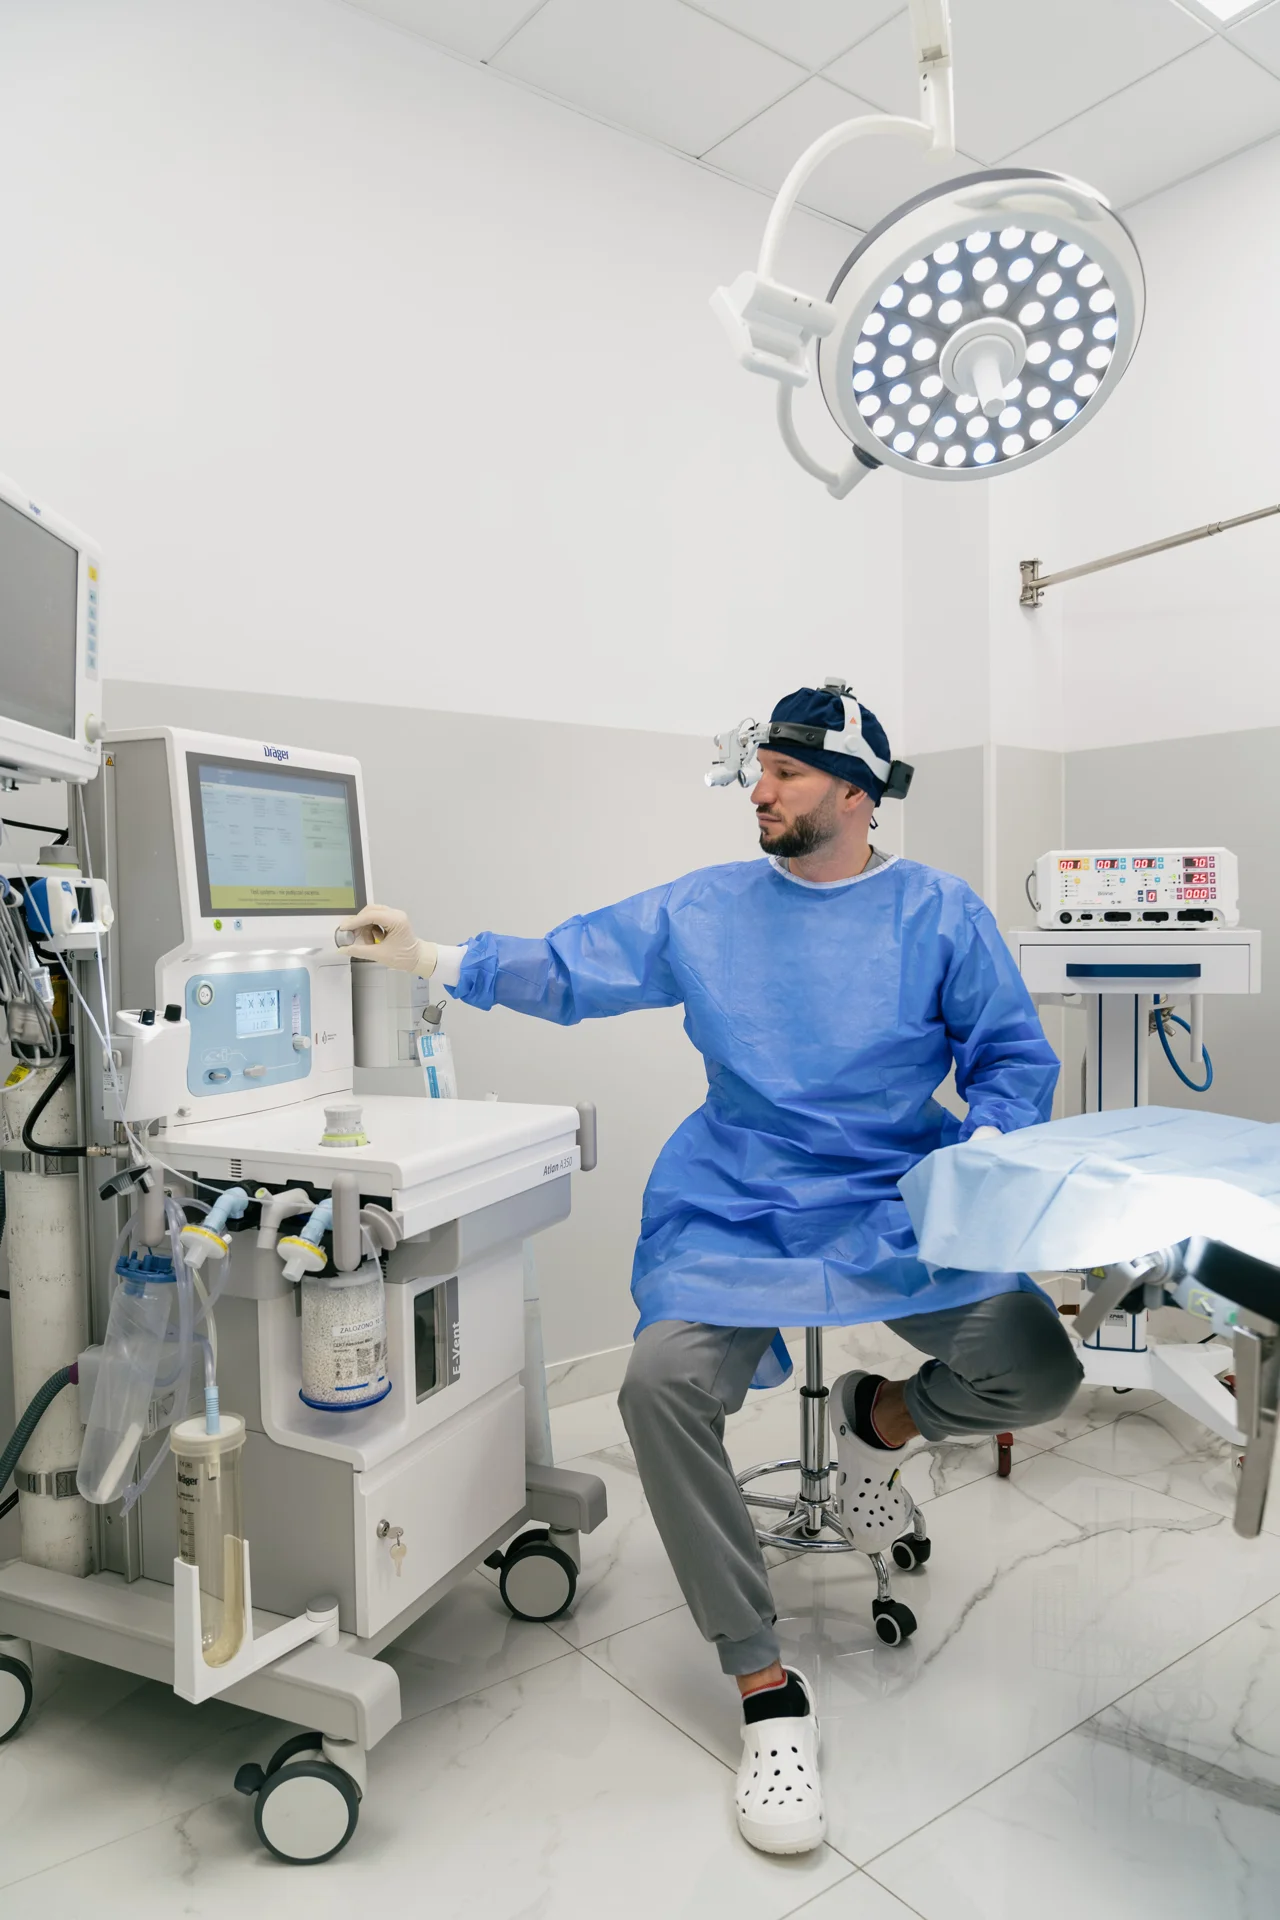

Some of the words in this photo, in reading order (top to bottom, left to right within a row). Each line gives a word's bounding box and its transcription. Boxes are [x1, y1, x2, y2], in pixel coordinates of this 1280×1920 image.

[263, 745, 289, 761] Dräger
[1060, 861, 1081, 869] 001
[1097, 860, 1118, 869] 001
[1134, 859, 1155, 868] 001
[1192, 858, 1206, 867] 70
[1185, 889, 1207, 898] 000
[543, 1163, 559, 1176] Atlan
[560, 1156, 573, 1169] A350
[452, 1321, 460, 1375] E-Vent
